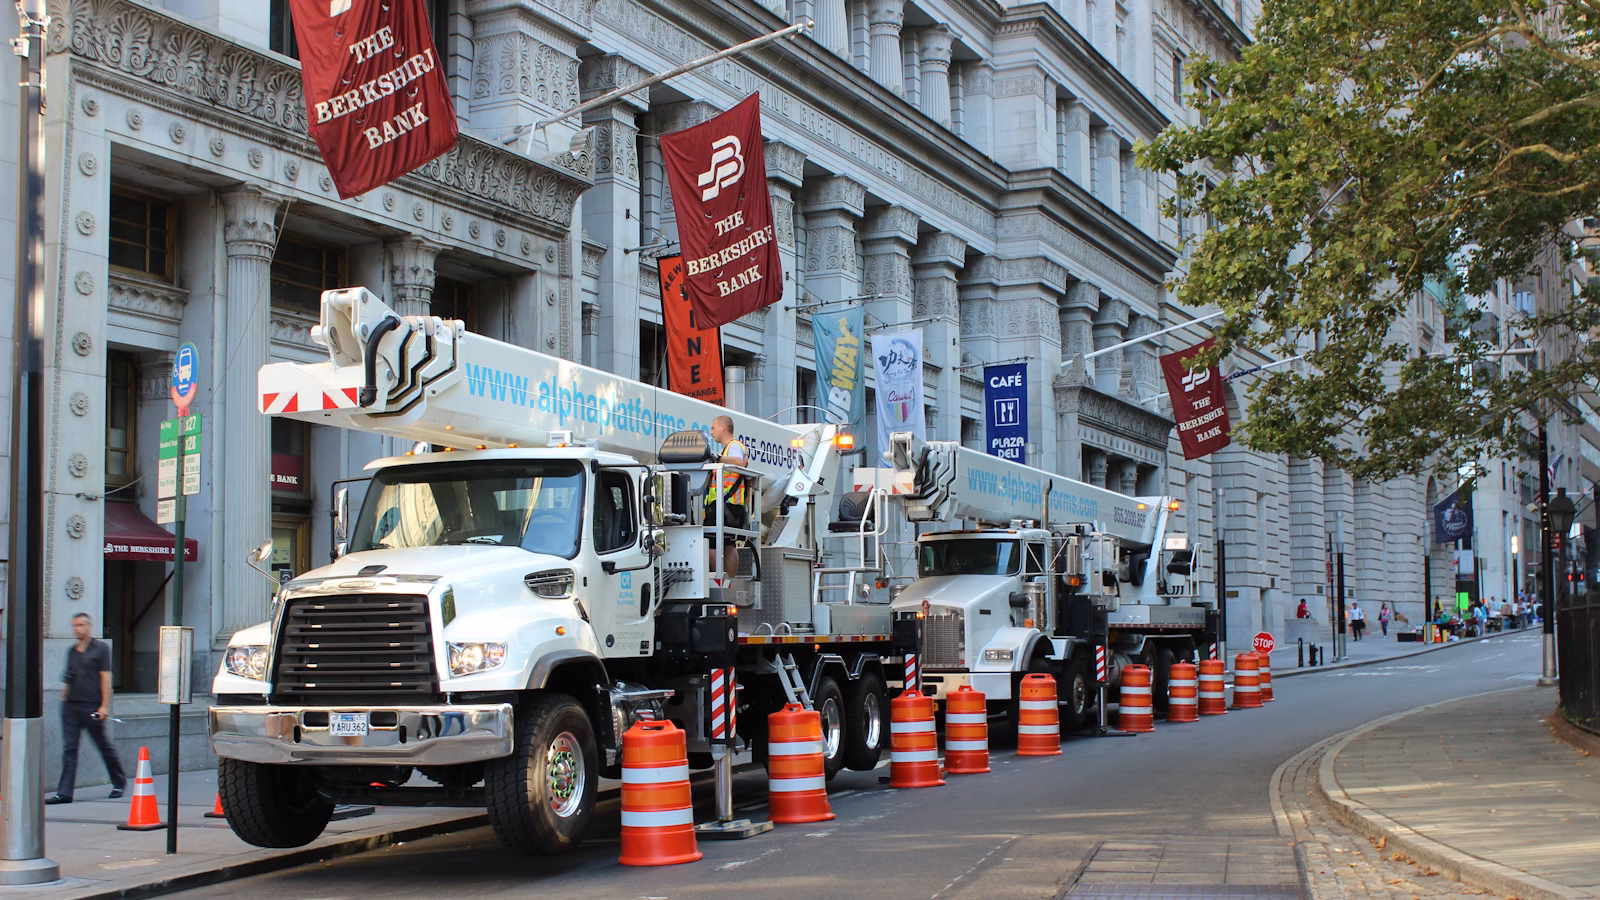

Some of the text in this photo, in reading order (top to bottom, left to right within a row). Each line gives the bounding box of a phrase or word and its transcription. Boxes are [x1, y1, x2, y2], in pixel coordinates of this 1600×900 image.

[349, 25, 394, 65] THE
[363, 101, 430, 150] BANK
[800, 103, 841, 147] GREEN
[714, 210, 744, 236] THE
[664, 263, 682, 292] NEW
[717, 264, 763, 297] BANK
[825, 316, 859, 425] UBWAY
[990, 371, 1022, 388] CAFÉ
[683, 386, 718, 398] CHANGE
[1192, 396, 1211, 410] THE
[465, 361, 721, 452] www.alphaplatforms
[1178, 406, 1224, 431] BERKSHIR
[992, 436, 1025, 448] PLAZA
[1196, 425, 1222, 443] BANK
[738, 434, 800, 469] 55-2000-85
[997, 448, 1020, 459] DELI
[277, 474, 298, 484] BANK
[967, 467, 1098, 518] www.alphaplforms.com
[130, 545, 170, 554] BERKSHIRE
[171, 547, 190, 555] BK
[1254, 637, 1273, 648] STOP
